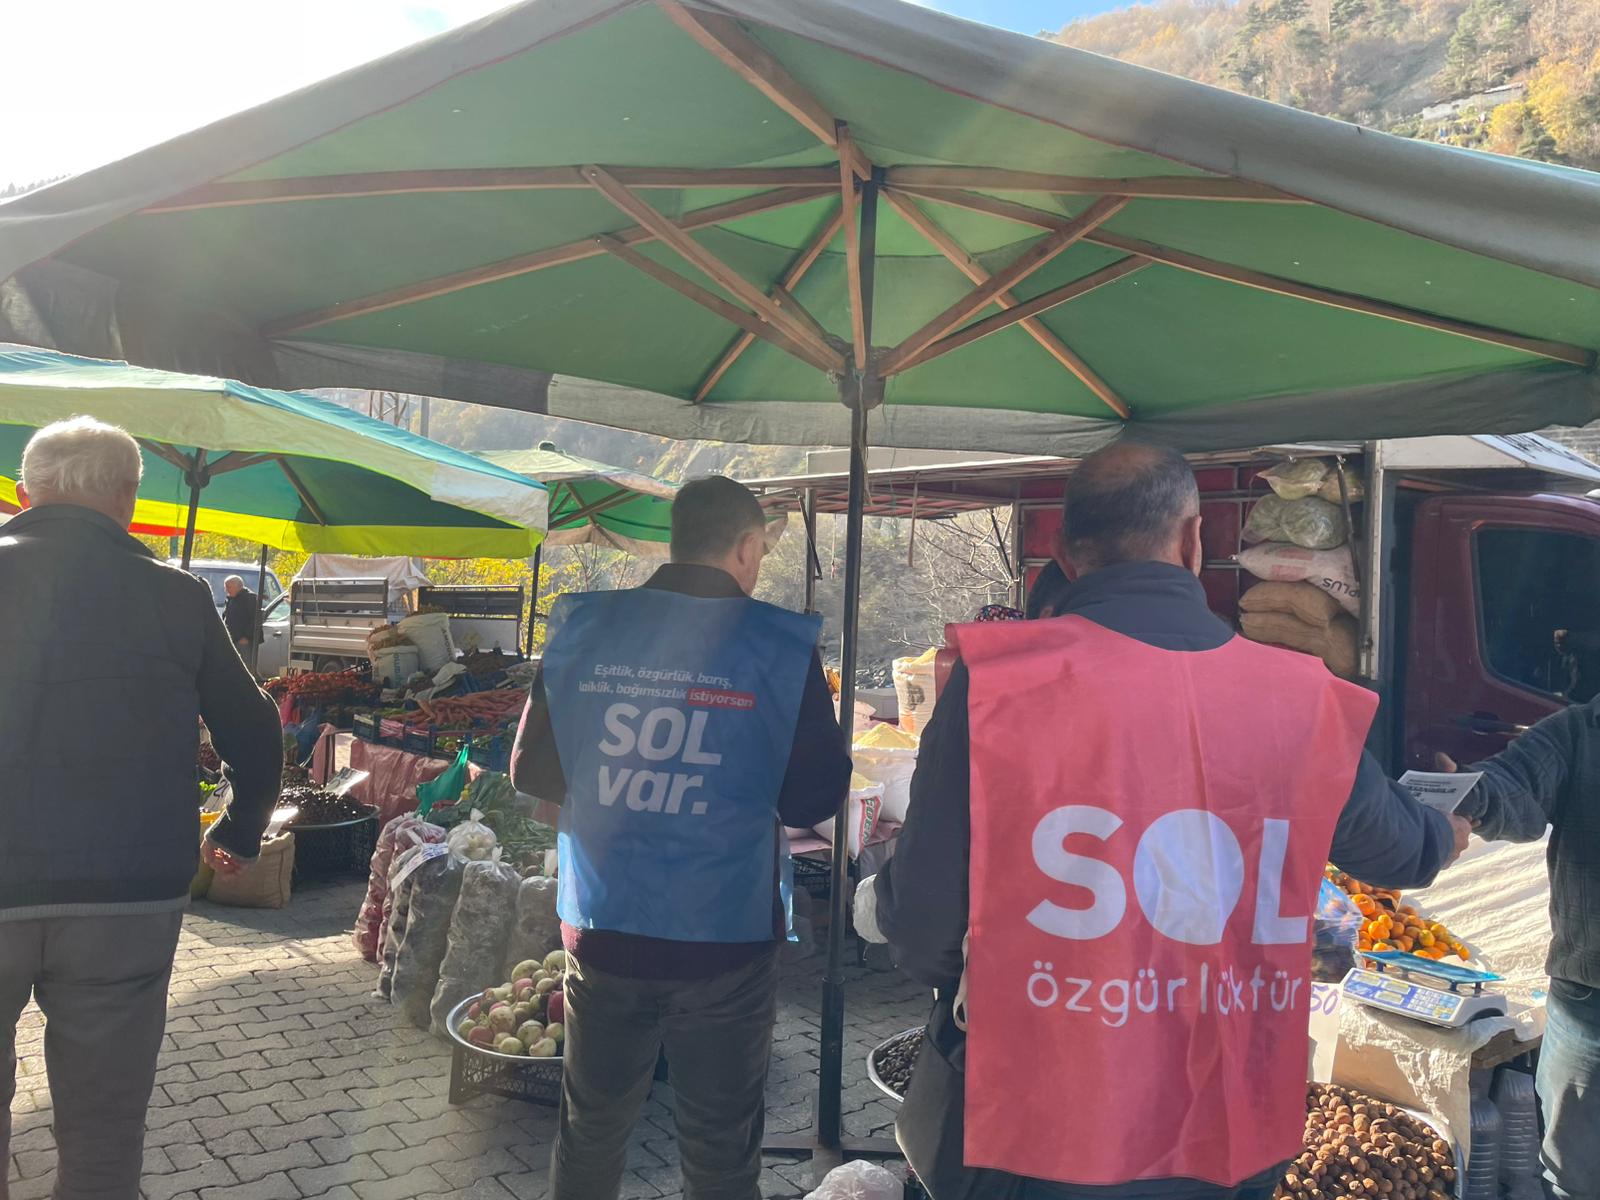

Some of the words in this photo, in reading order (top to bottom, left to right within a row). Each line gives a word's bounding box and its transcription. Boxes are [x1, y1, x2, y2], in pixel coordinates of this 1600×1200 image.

[594, 664, 635, 678] Eşitlik,
[688, 688, 753, 707] istiyorsan
[598, 702, 722, 766] SOL
[598, 765, 708, 815] var.
[1025, 804, 1309, 945] SOL
